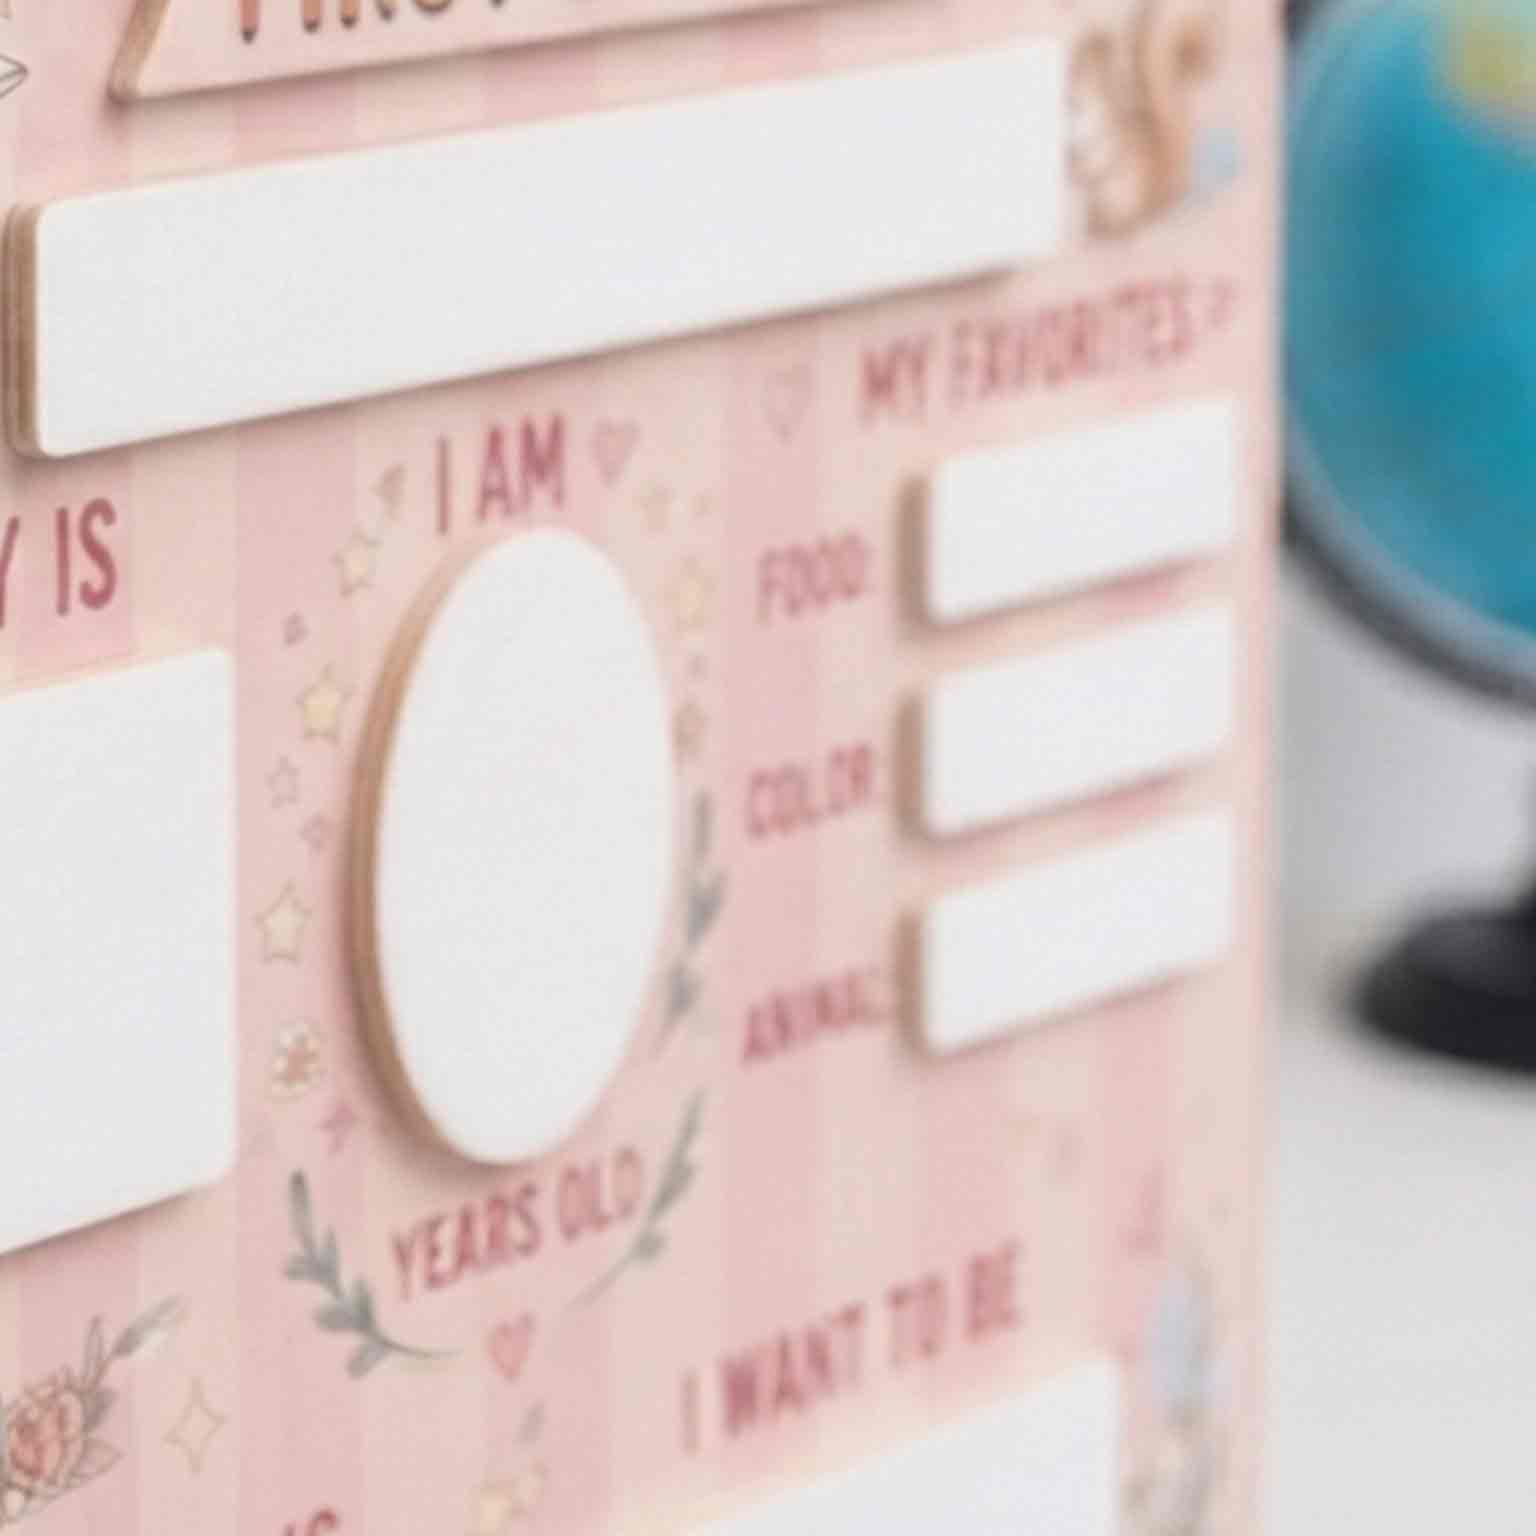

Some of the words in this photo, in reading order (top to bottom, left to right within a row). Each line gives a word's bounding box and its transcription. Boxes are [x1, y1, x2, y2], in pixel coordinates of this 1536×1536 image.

[474, 412, 566, 520] AM
[54, 496, 119, 618] IS
[390, 1182, 542, 1300] YEARS
[557, 1146, 644, 1242] OLD
[718, 1304, 862, 1438] WANT
[888, 1272, 946, 1368] TO
